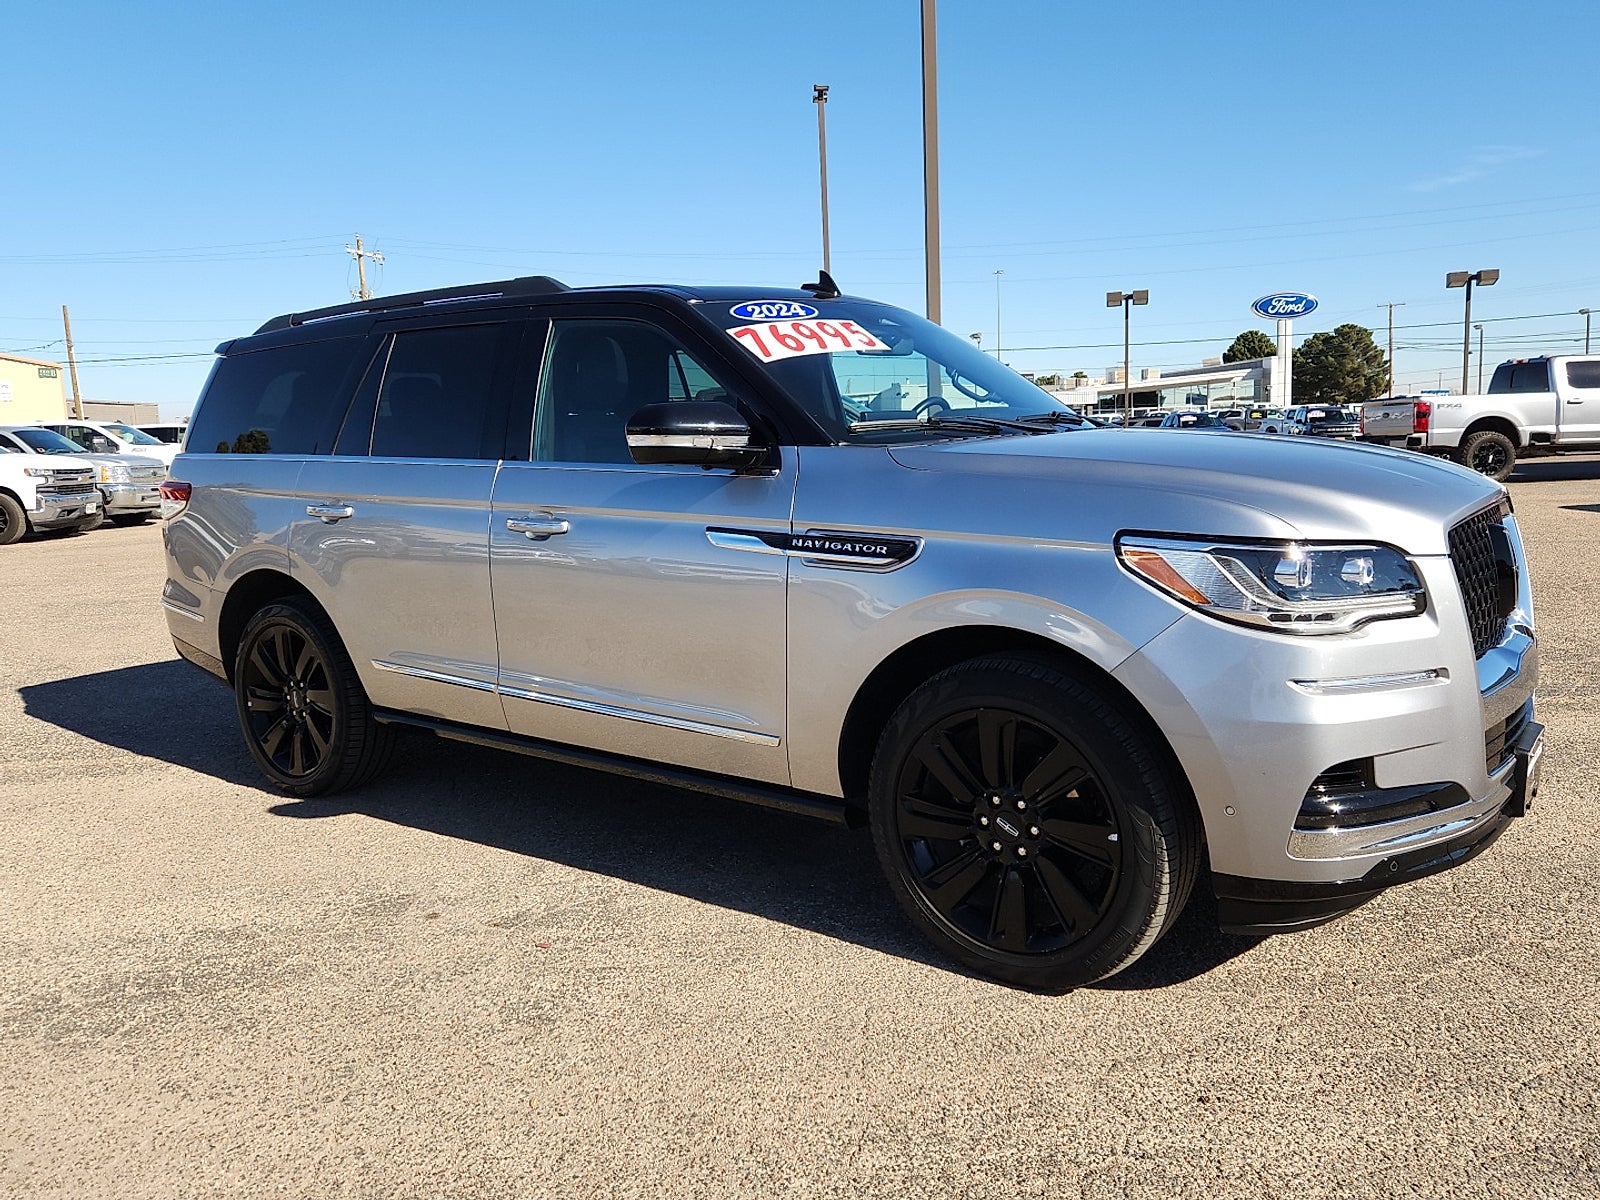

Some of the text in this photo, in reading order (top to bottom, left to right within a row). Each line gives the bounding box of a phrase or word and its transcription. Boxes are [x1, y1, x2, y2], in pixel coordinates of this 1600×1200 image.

[746, 303, 807, 319] 2024
[1267, 296, 1307, 314] Ford
[733, 321, 877, 358] 76995
[791, 538, 888, 555] NAVIGATOR
